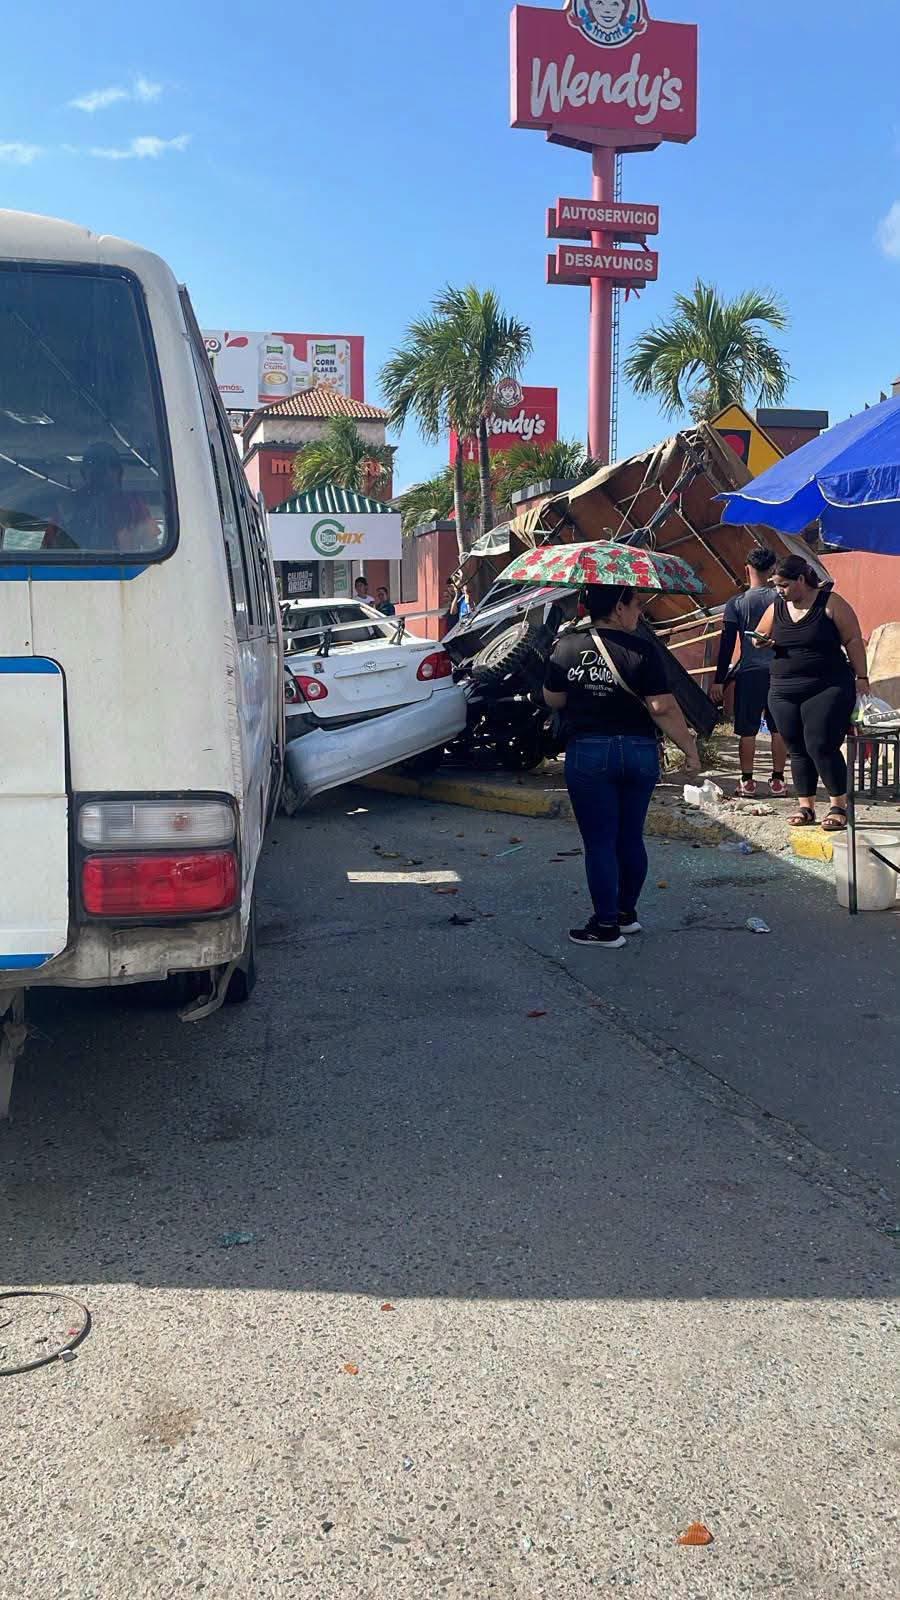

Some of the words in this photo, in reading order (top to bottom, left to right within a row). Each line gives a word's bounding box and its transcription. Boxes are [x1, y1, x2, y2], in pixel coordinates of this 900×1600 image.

[531, 53, 683, 124] Wendy's
[561, 206, 656, 225] AUTOSERVICIO
[565, 252, 654, 272] DESAYUNOS
[288, 578, 313, 593] ORIGEN
